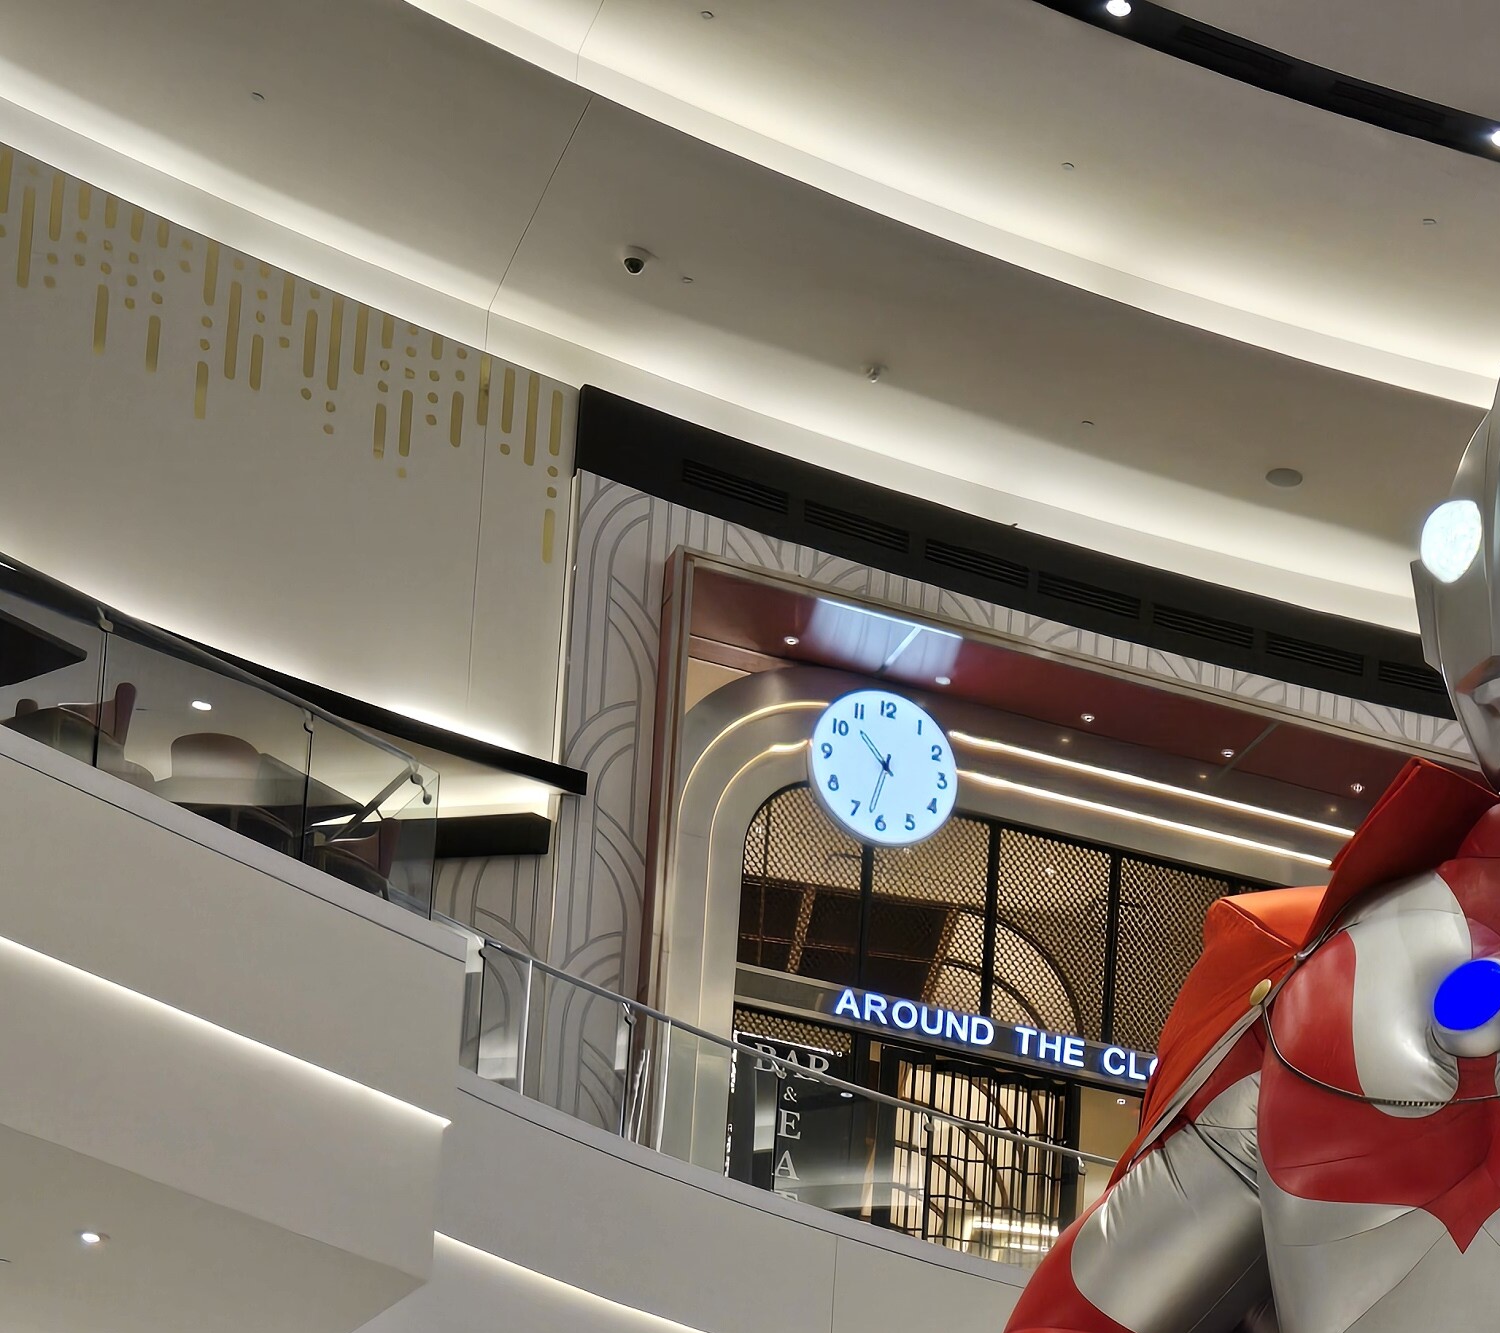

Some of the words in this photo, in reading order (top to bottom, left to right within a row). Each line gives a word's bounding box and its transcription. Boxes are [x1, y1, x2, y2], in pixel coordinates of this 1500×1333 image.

[854, 702, 865, 720] 11
[880, 700, 897, 719] 12
[832, 718, 849, 736] 10
[917, 719, 923, 735] 1
[820, 742, 833, 759] 9
[931, 744, 943, 762] 2
[827, 774, 840, 791] 8
[937, 771, 948, 790] 3
[850, 799, 861, 816] 7
[926, 797, 937, 814] 4
[874, 814, 887, 832] 6
[904, 813, 916, 831] 5
[834, 988, 995, 1046] AROUND
[1014, 1026, 1086, 1068] THE
[1102, 1047, 1158, 1081] CL
[774, 1108, 801, 1201] EA
